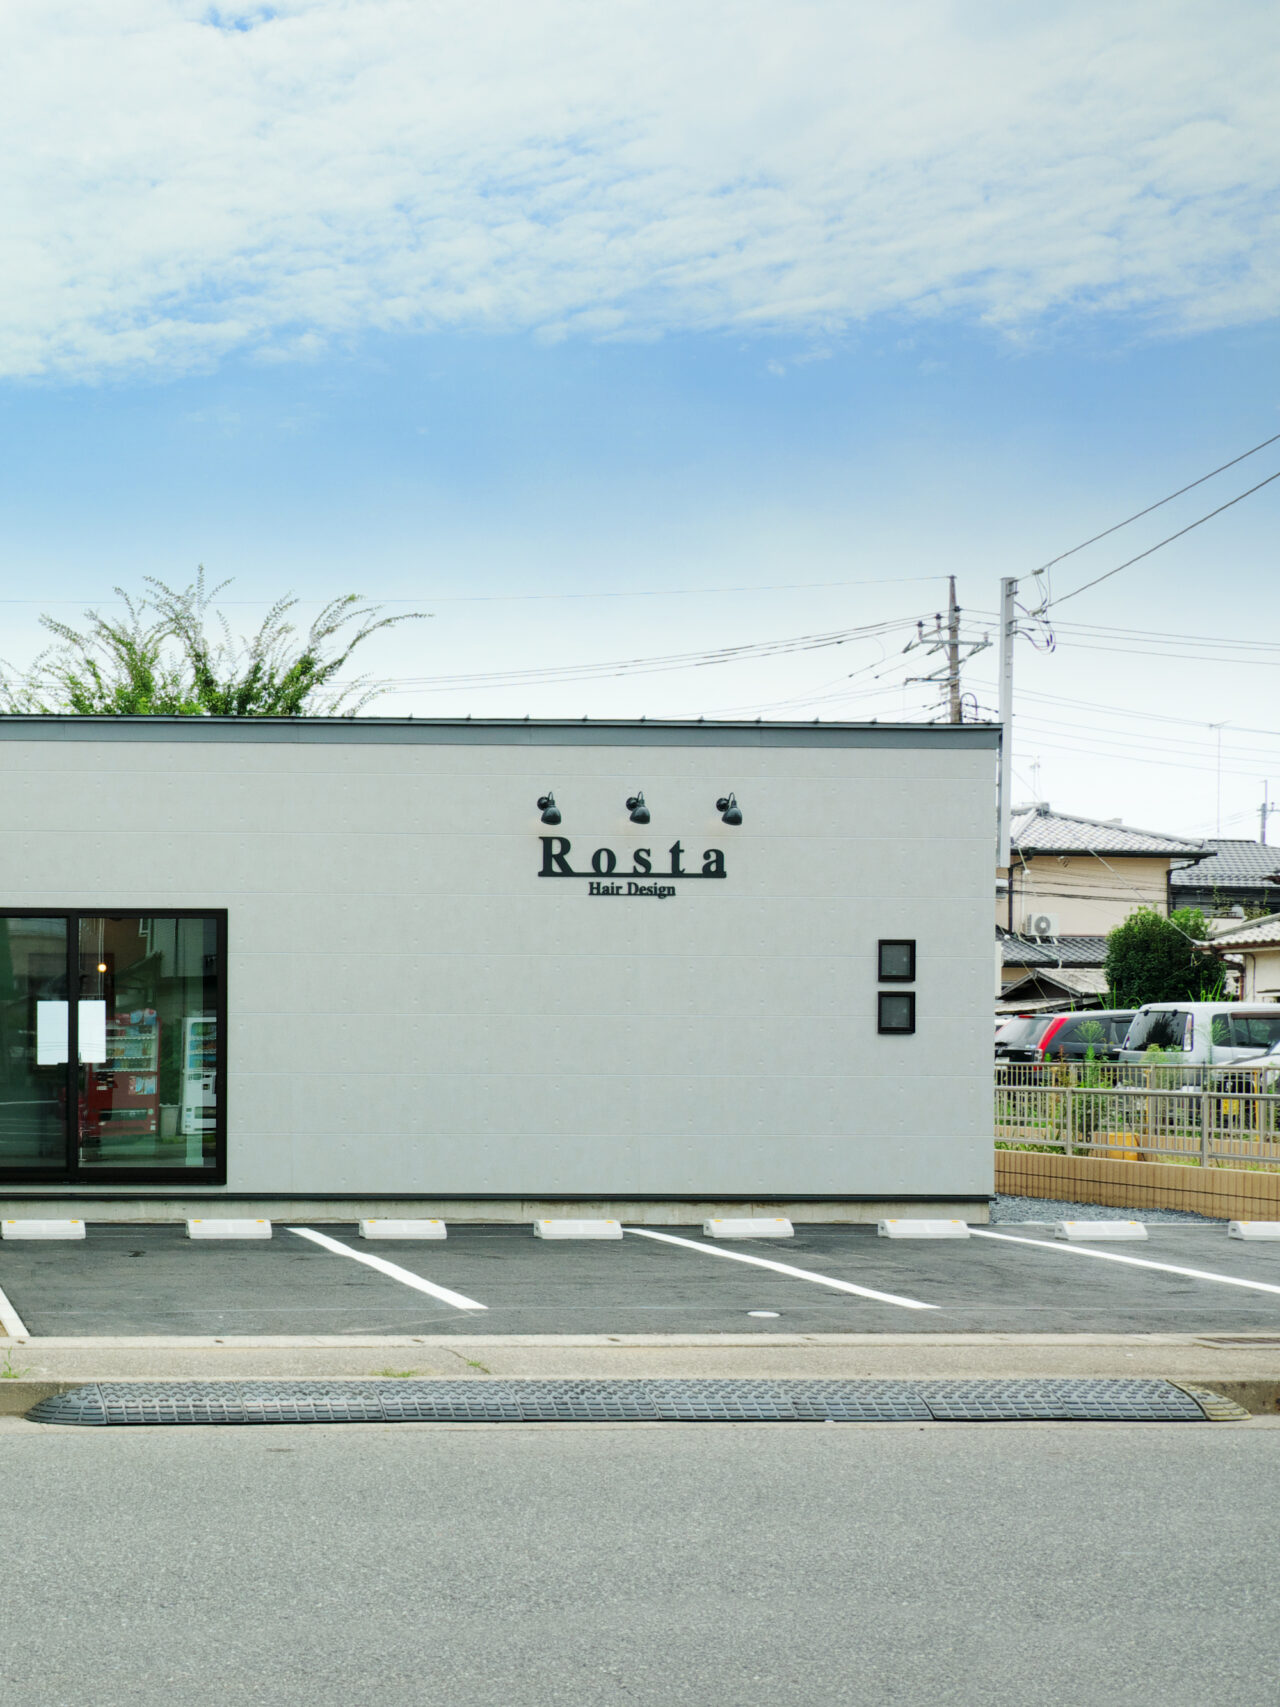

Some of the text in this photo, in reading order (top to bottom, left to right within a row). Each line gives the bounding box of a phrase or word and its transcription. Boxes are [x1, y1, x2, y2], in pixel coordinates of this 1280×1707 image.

[538, 836, 727, 876] Rosta
[588, 881, 676, 899] Hair Design
